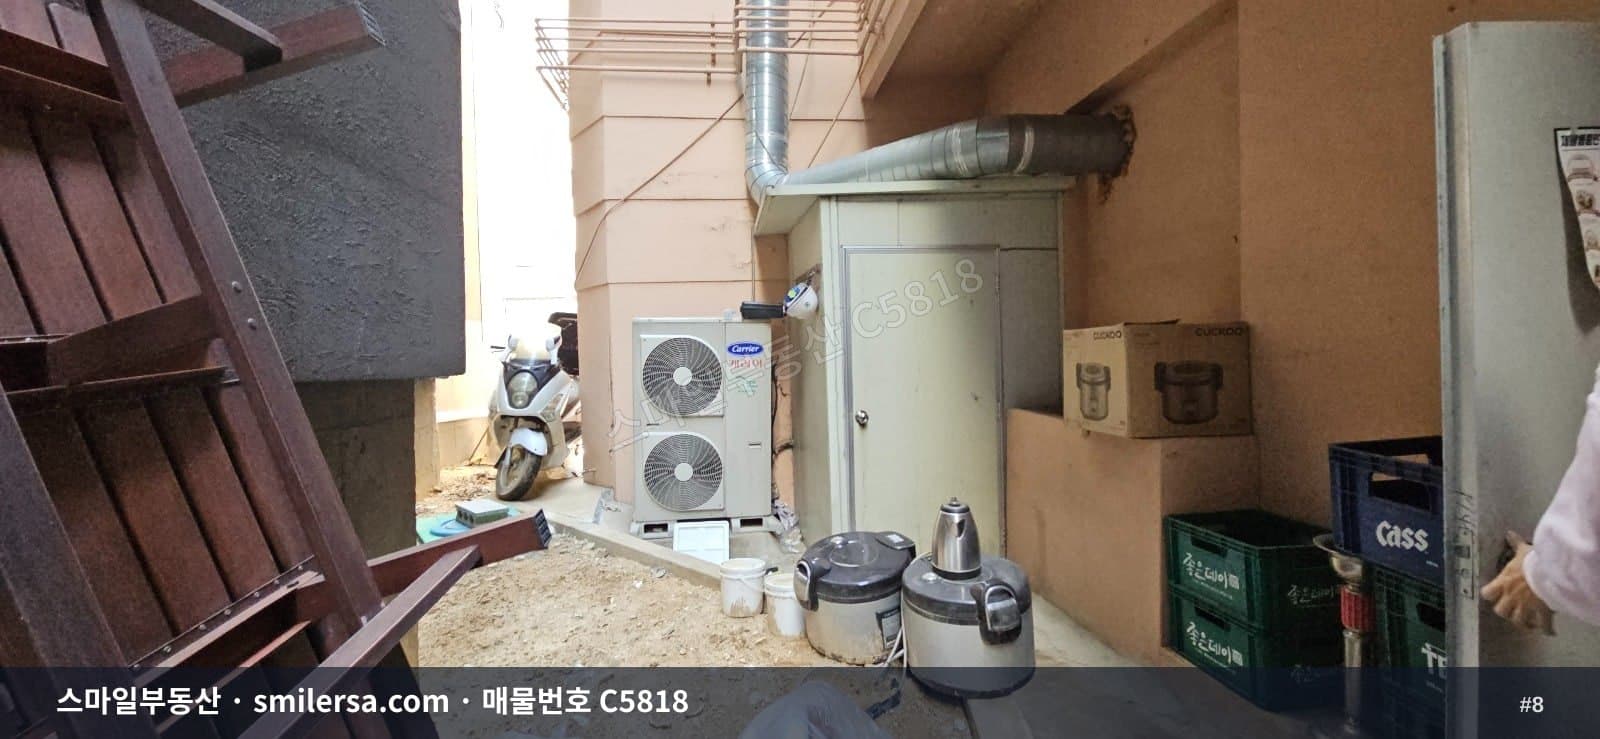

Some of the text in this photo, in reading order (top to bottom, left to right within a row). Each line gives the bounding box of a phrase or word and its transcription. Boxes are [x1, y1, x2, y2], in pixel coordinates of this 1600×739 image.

[1093, 330, 1122, 341] CUCKOO
[1194, 327, 1243, 337] CUCKOO
[1375, 520, 1429, 552] Cass
[1183, 552, 1229, 589] 좋은데이
[1186, 621, 1232, 665] 좋은데이
